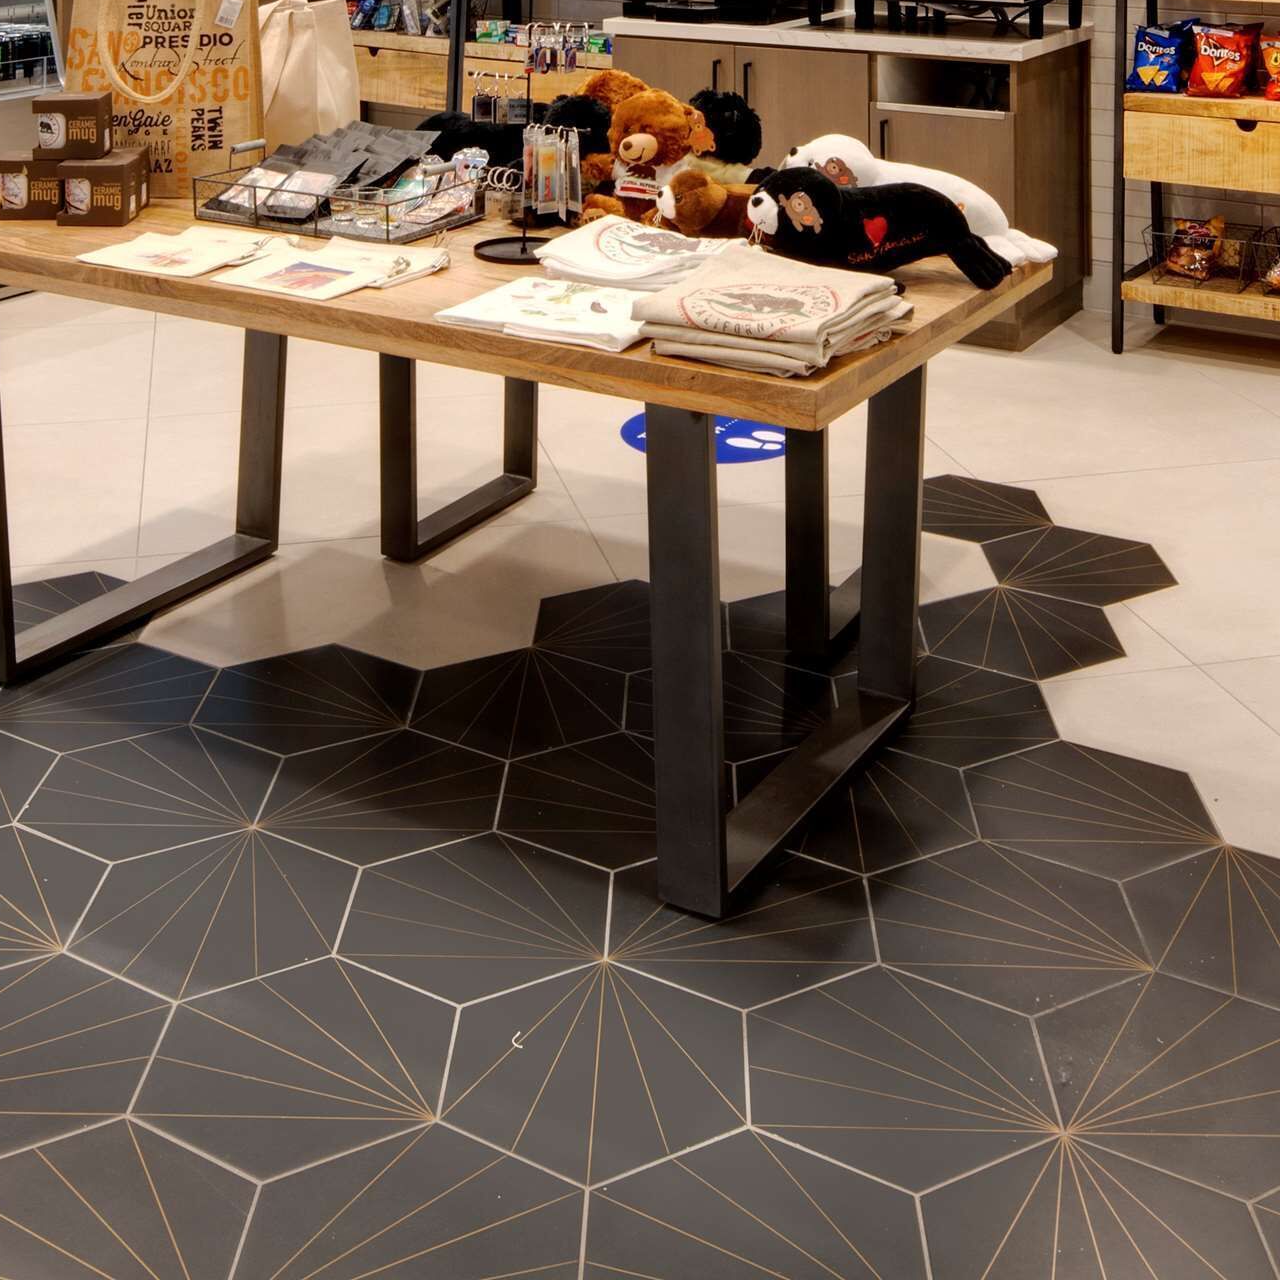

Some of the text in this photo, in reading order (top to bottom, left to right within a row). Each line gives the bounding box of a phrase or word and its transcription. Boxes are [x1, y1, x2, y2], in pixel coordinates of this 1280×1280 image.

[144, 21, 192, 32] SQUAR
[142, 33, 234, 48] PRESDIO
[1138, 41, 1176, 55] Doritos
[1200, 45, 1241, 61] Doritos
[68, 120, 96, 128] CERAMIC
[191, 108, 206, 152] PEAKS
[207, 106, 223, 151] TWIN
[68, 128, 97, 143] mug
[31, 181, 59, 189] CERAMIC
[93, 187, 121, 195] CERAMIC
[30, 189, 59, 204] mug
[93, 195, 121, 211] mug
